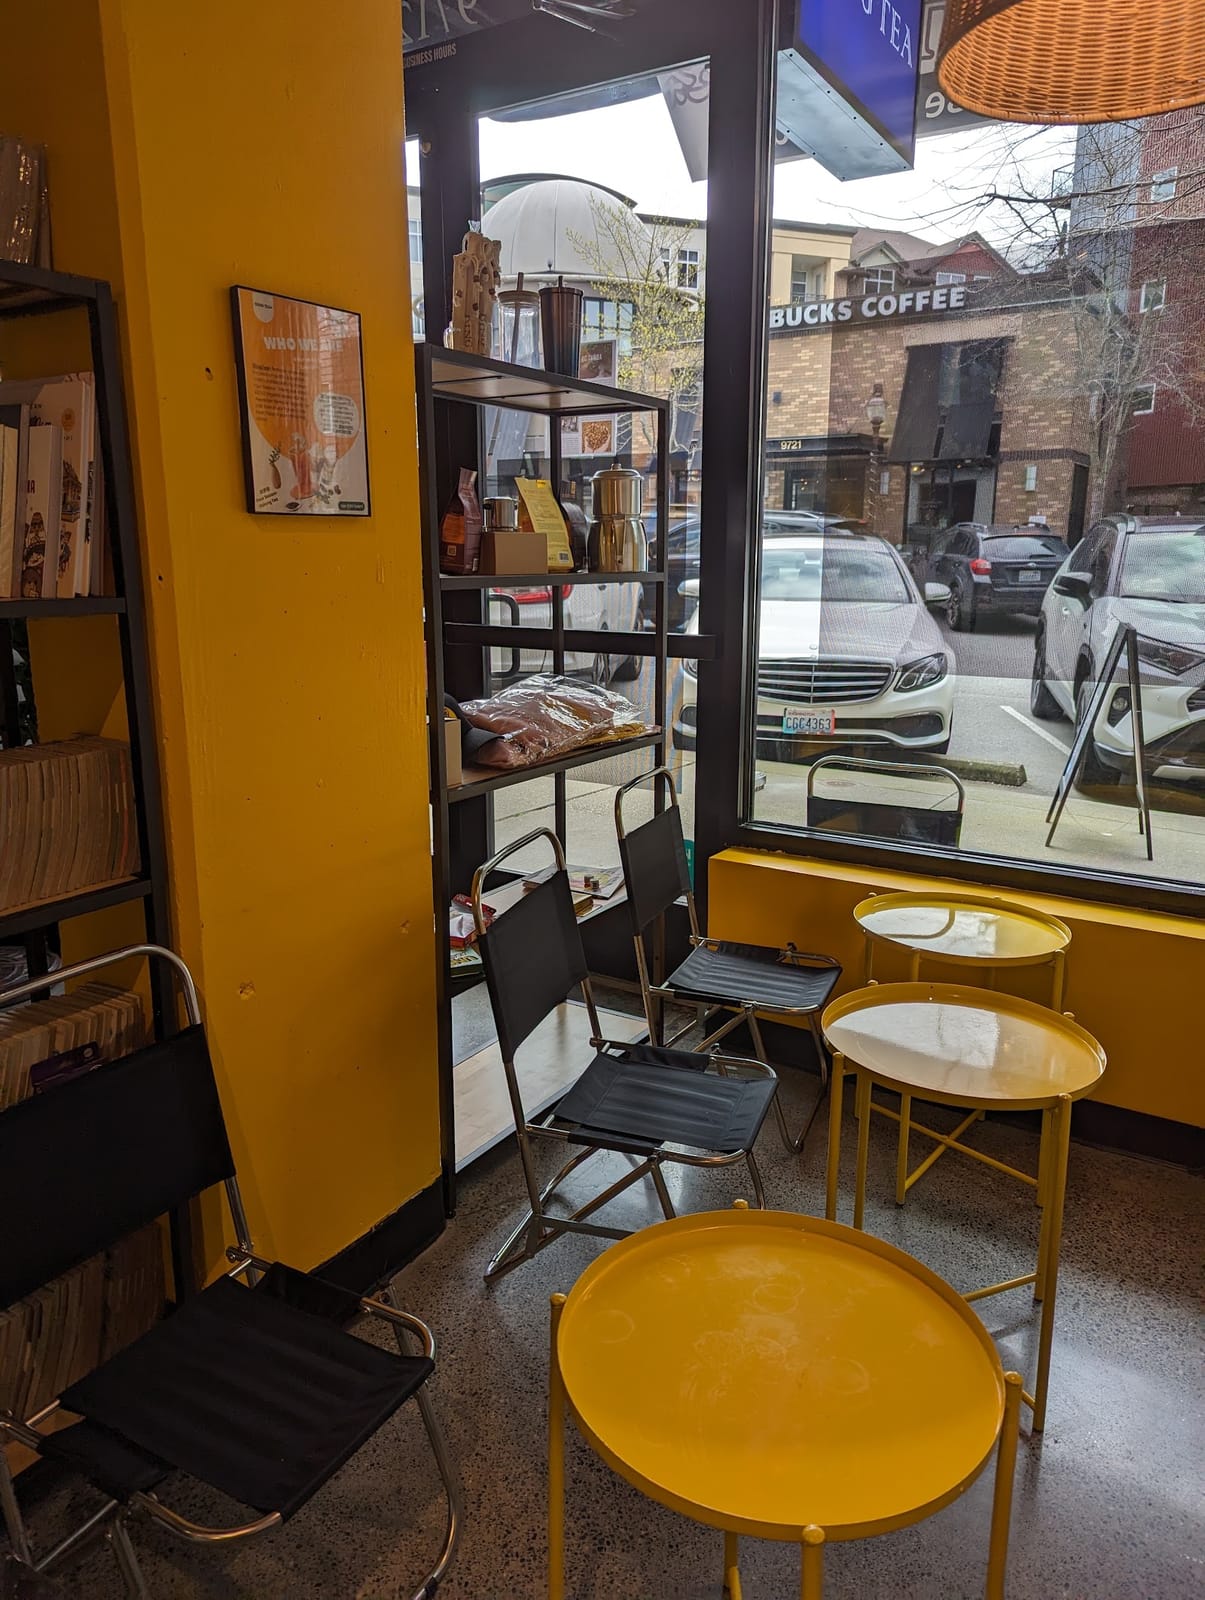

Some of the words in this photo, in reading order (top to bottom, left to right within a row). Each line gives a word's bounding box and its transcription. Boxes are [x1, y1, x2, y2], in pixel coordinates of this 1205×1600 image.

[880, 0, 912, 68] TEA
[404, 50, 432, 68] USINESS
[433, 43, 456, 60] HOURS
[769, 301, 852, 329] BUCKS
[861, 287, 965, 317] COFFEE
[264, 336, 296, 350] WHO
[780, 440, 802, 450] 9721
